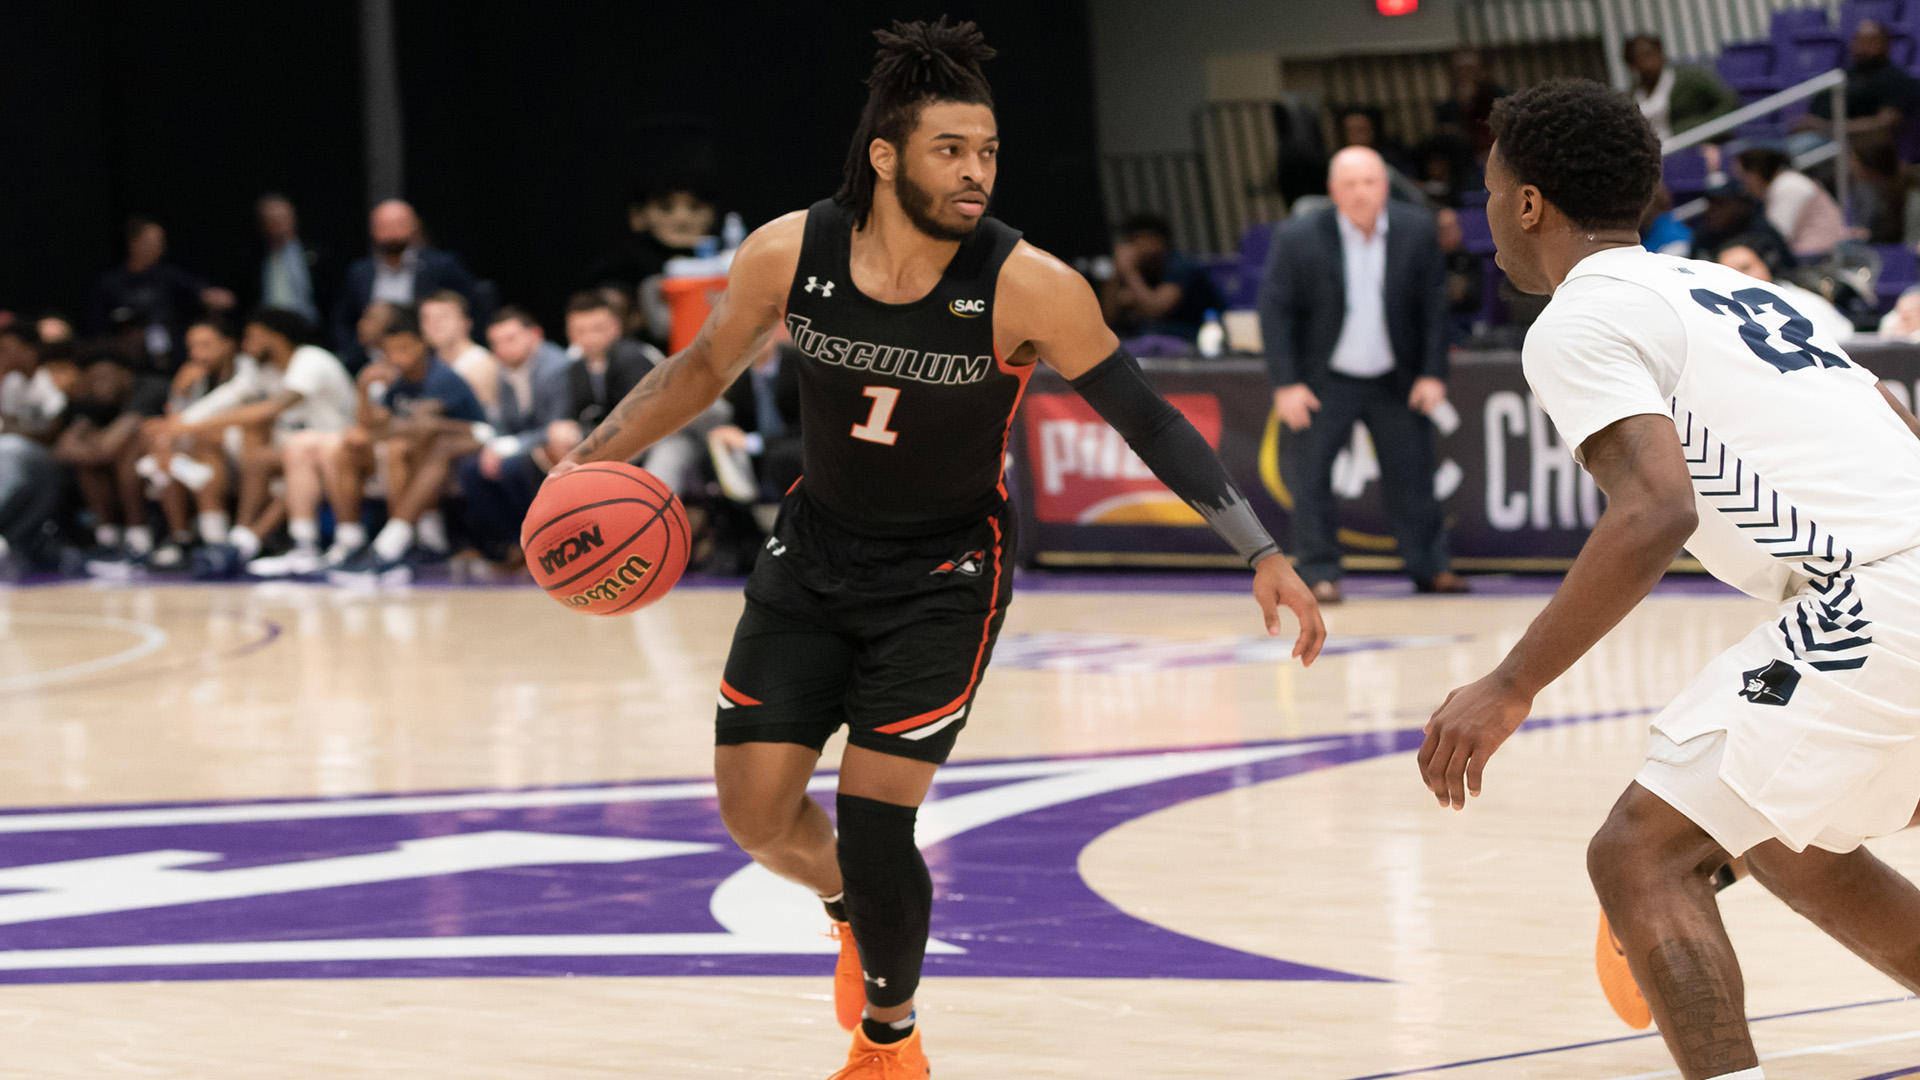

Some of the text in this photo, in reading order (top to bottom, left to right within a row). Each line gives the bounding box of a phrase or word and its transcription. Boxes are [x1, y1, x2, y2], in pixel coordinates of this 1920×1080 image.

[954, 299, 985, 312] SAC
[1689, 287, 1852, 374] 22
[850, 386, 901, 446] 1
[537, 524, 604, 576] NCAA
[562, 553, 653, 608] Wilson
